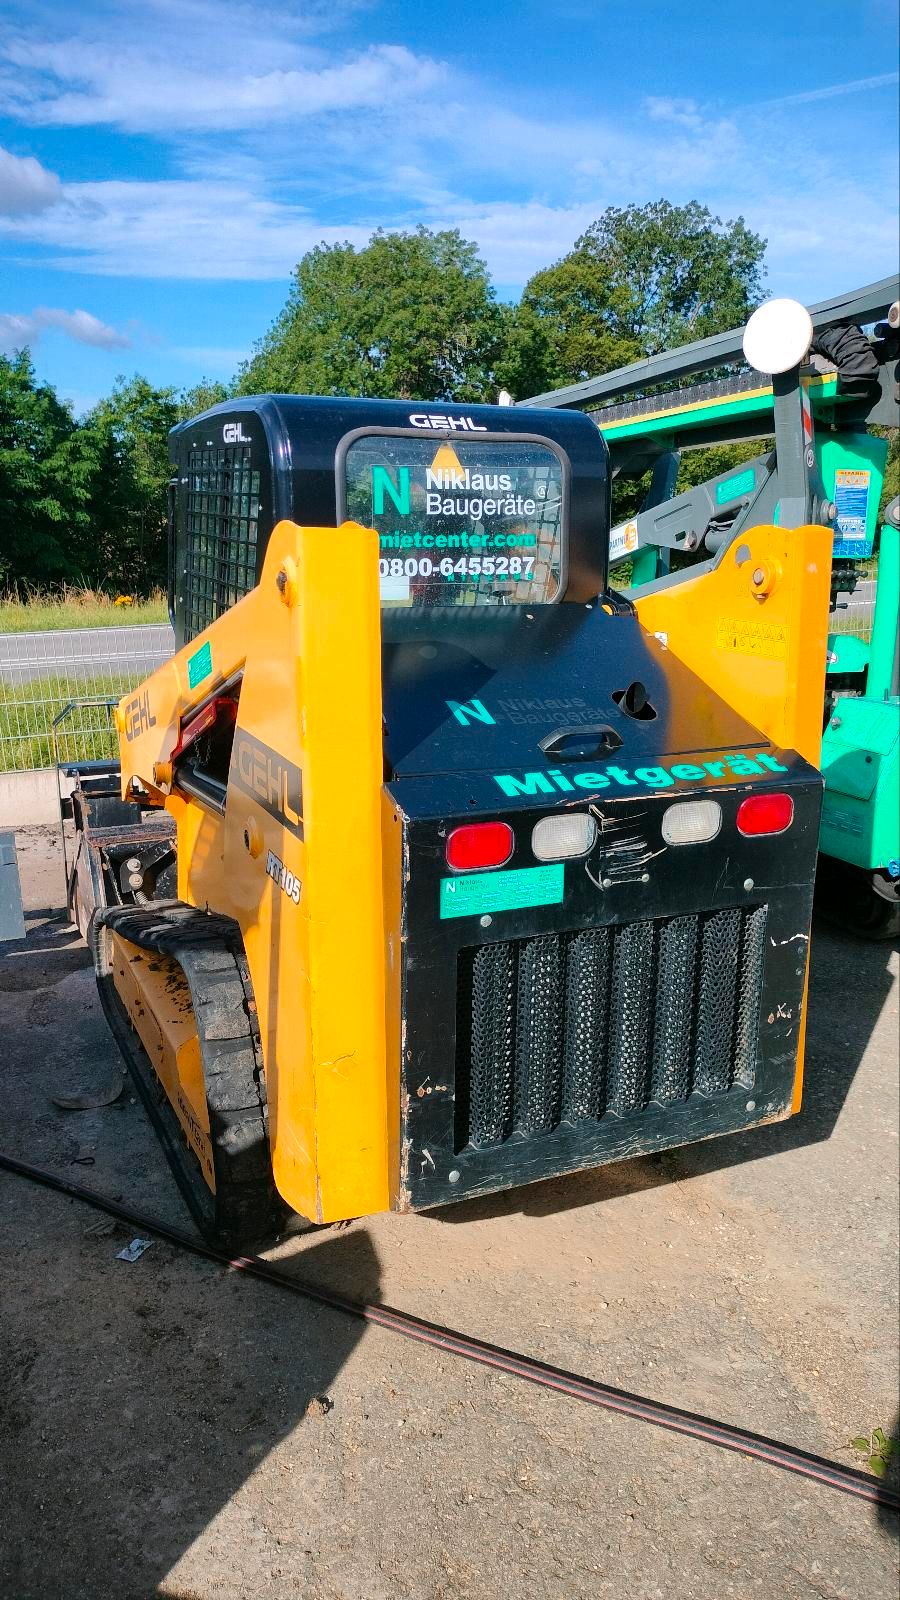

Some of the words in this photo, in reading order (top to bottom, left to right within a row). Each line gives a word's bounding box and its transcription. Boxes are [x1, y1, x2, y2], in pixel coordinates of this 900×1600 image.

[223, 422, 248, 443] GEHL
[409, 414, 487, 431] GEHL
[372, 465, 411, 515] N
[425, 468, 512, 491] Niklaus
[426, 493, 536, 521] Baugeräte
[379, 557, 535, 577] 0800-6455287
[125, 689, 156, 742] GEHL
[445, 699, 497, 726] N
[498, 697, 587, 711] Niklaus
[509, 707, 622, 726] Baugeräte
[238, 739, 304, 827] GEHL
[493, 753, 789, 797] Mietgerät
[266, 849, 302, 905] RT105
